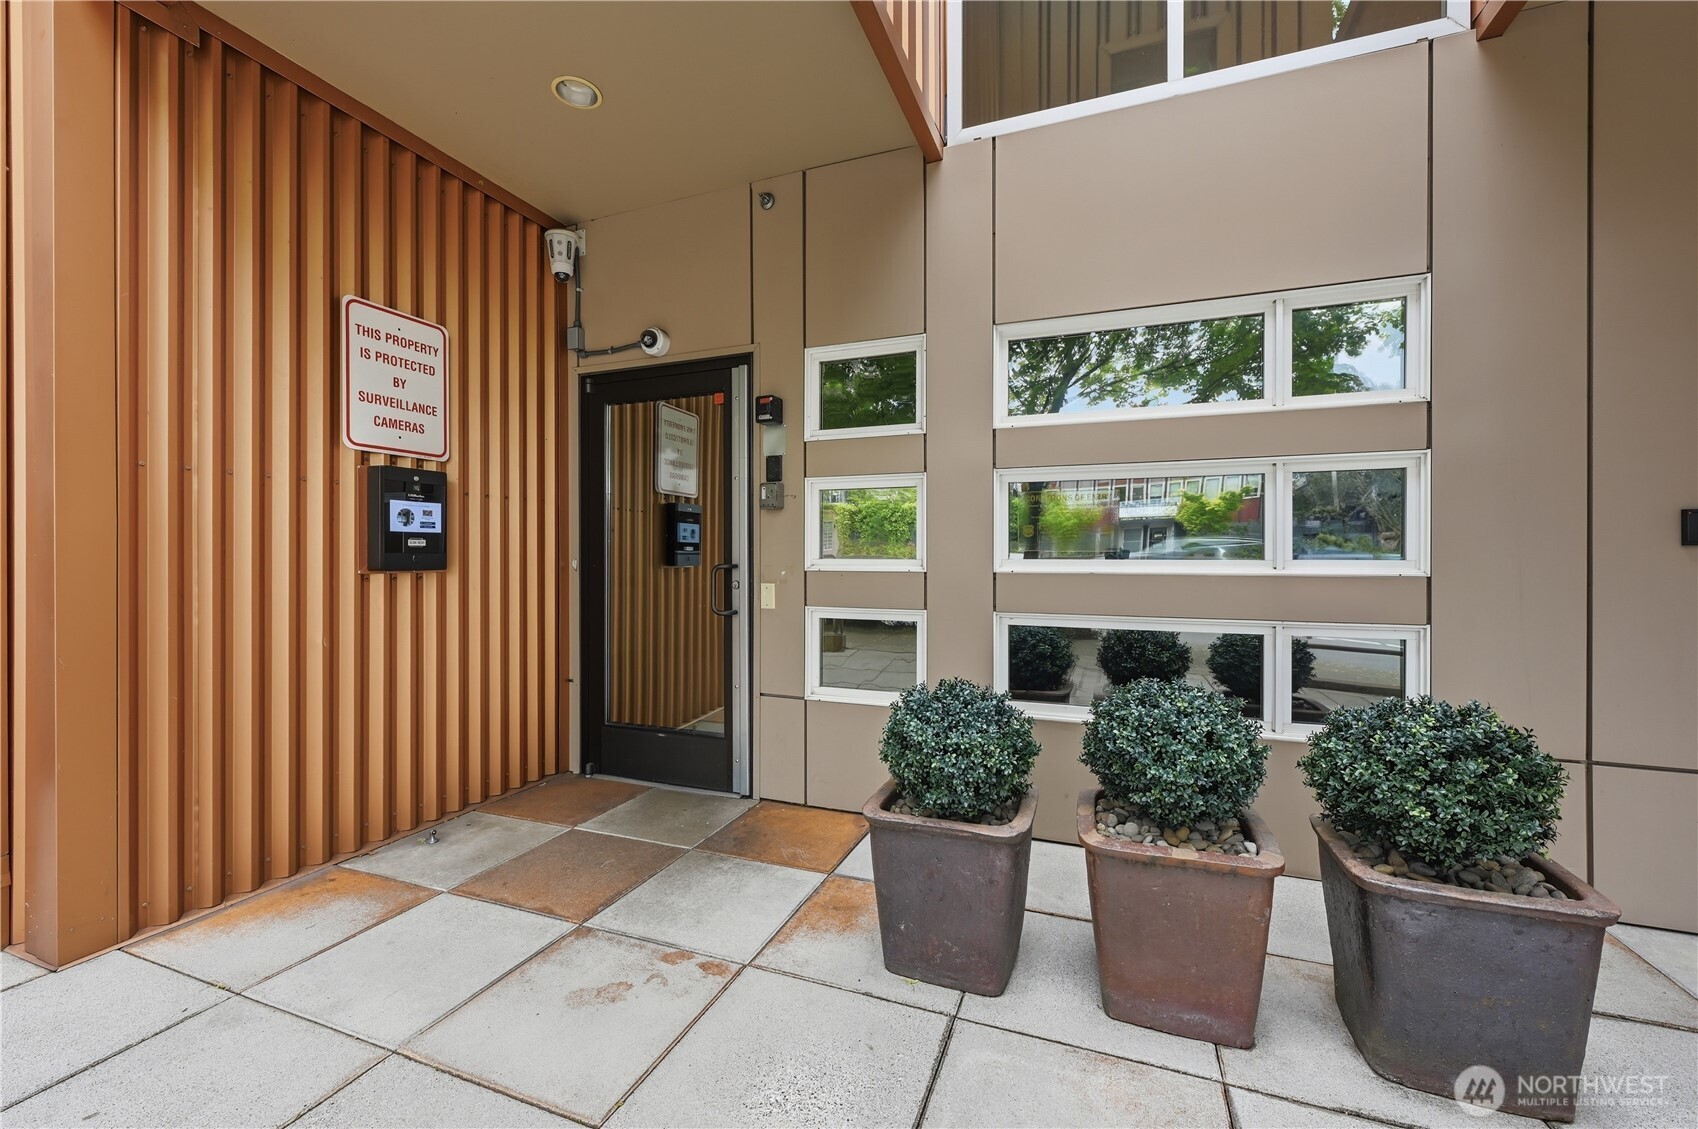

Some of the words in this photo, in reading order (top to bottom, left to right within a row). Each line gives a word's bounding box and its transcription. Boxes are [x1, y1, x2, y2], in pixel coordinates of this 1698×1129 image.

[355, 323, 382, 341] THIS
[385, 332, 439, 357] PROPERTY
[360, 346, 371, 360] IS
[375, 351, 436, 377] PROTECTED
[393, 376, 407, 389] BY
[358, 390, 438, 417] SURVEILLANCE
[373, 415, 425, 434] CAMERAS
[1075, 493, 1085, 501] OF
